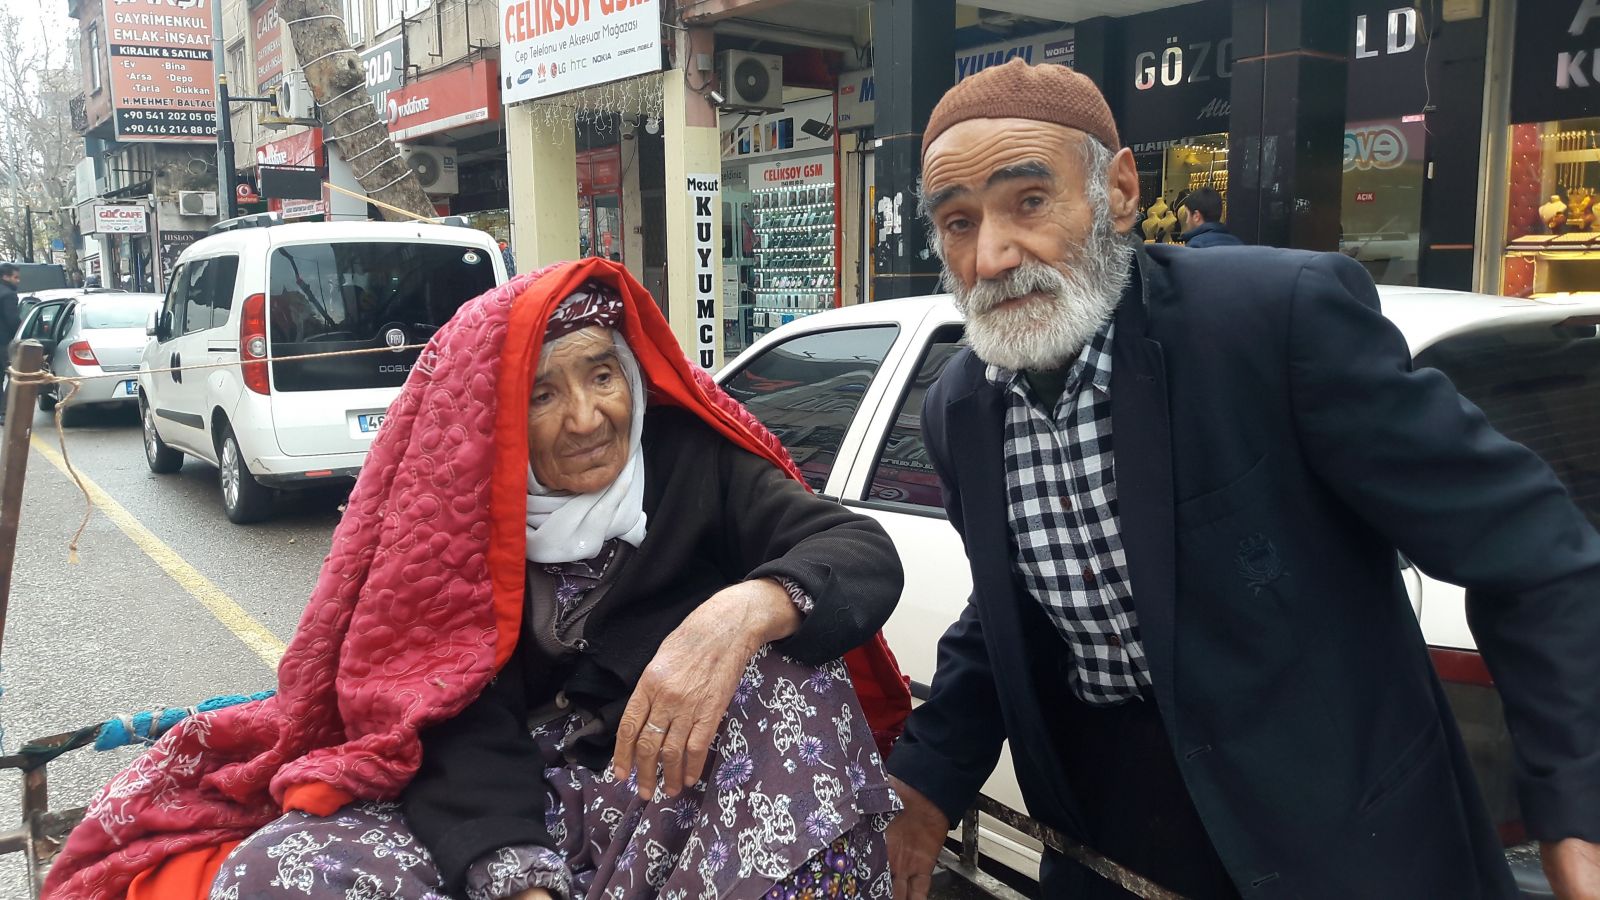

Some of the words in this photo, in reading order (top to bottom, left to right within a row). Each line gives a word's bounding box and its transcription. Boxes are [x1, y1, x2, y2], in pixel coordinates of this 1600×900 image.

[114, 11, 208, 29] GAYRİMENKUL
[113, 29, 211, 45] EMLAK-İNŞAAT
[514, 50, 529, 64] Cep
[529, 42, 558, 60] Telefonu
[558, 40, 567, 50] ve
[568, 31, 601, 49] Aksesuar
[602, 19, 638, 40] Mağazası
[162, 48, 170, 57] &
[171, 48, 209, 59] SATILIK
[123, 60, 136, 68] Ev
[164, 61, 186, 70] Bina
[558, 62, 567, 75] LG
[592, 52, 612, 64] NOKIA
[129, 72, 152, 81] Arsa
[169, 73, 193, 84] Depo
[135, 84, 160, 93] Tarla
[175, 85, 210, 95] Dükkan
[122, 97, 174, 106] H.MEHMET
[398, 96, 430, 118] vodafone
[123, 111, 143, 119] +90
[145, 111, 164, 120] 541
[167, 112, 187, 121] 202
[189, 112, 202, 121] 05
[204, 113, 216, 122] 05
[124, 125, 144, 133] +90
[146, 125, 166, 133] 416
[168, 125, 188, 134] 214
[190, 126, 203, 134] 88
[205, 126, 217, 134] 08
[803, 163, 823, 178] GSM
[687, 177, 719, 192] Mesut
[119, 211, 143, 219] CAFE
[695, 196, 715, 369] KUYUMCU
